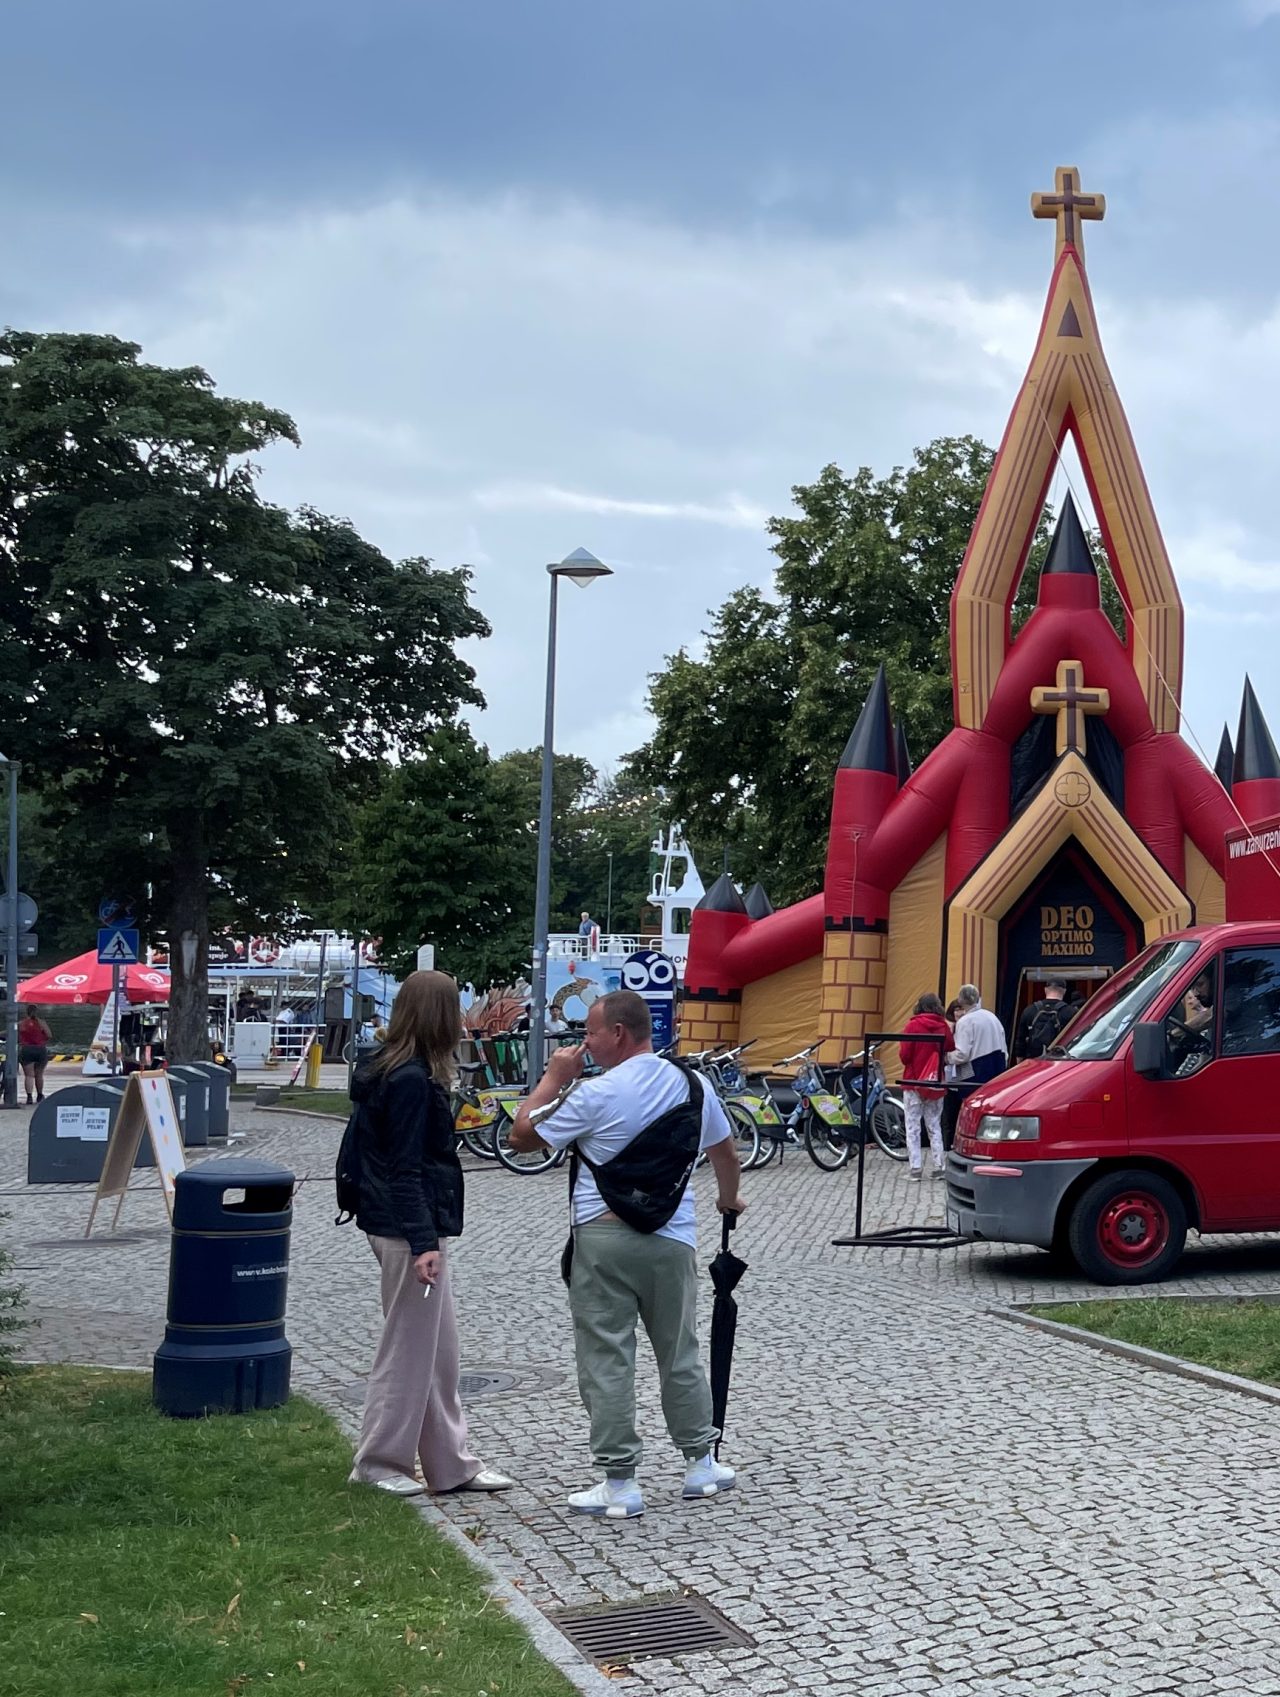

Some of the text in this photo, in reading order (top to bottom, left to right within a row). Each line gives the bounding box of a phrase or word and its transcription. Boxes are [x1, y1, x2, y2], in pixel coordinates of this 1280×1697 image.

[1041, 906, 1094, 929] DEO
[1042, 930, 1094, 942] OPTIMO
[1042, 943, 1095, 956] MAXIMO
